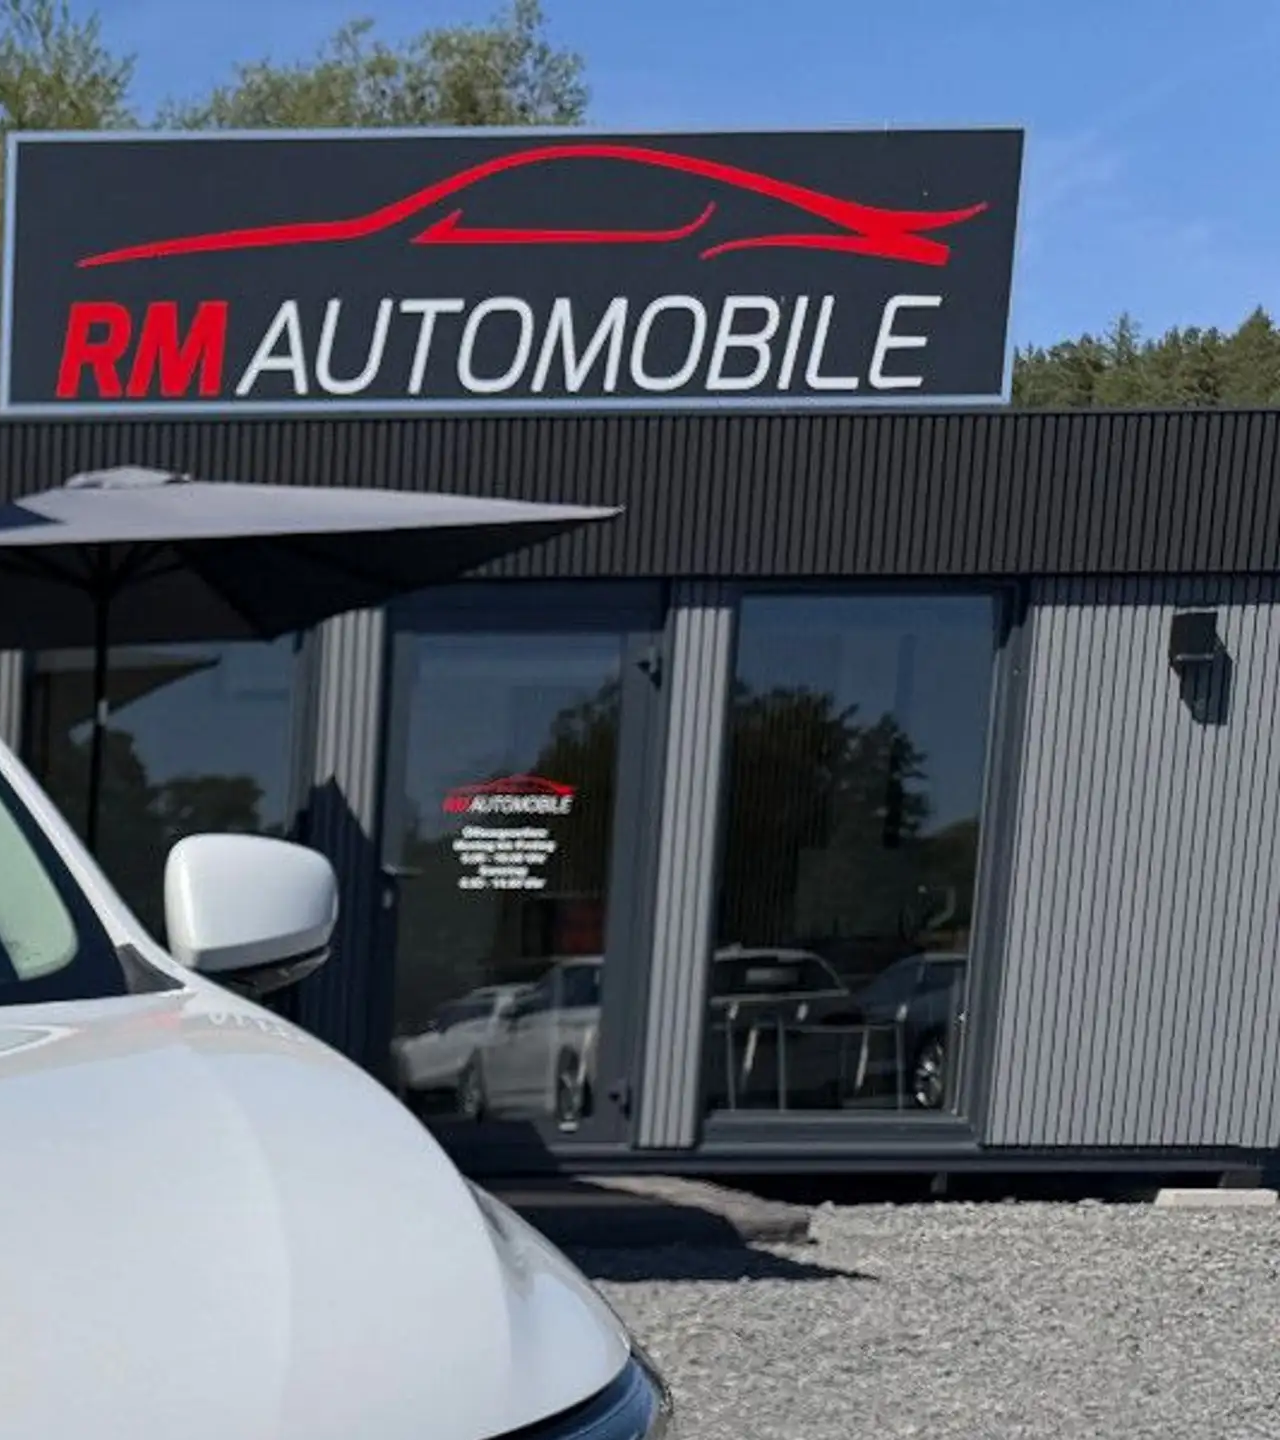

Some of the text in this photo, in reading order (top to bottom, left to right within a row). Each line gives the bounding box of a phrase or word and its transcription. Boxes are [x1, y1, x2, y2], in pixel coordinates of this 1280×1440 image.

[54, 293, 945, 399] RM AUTOMOBILE
[468, 794, 573, 814] AUTOMOBILE
